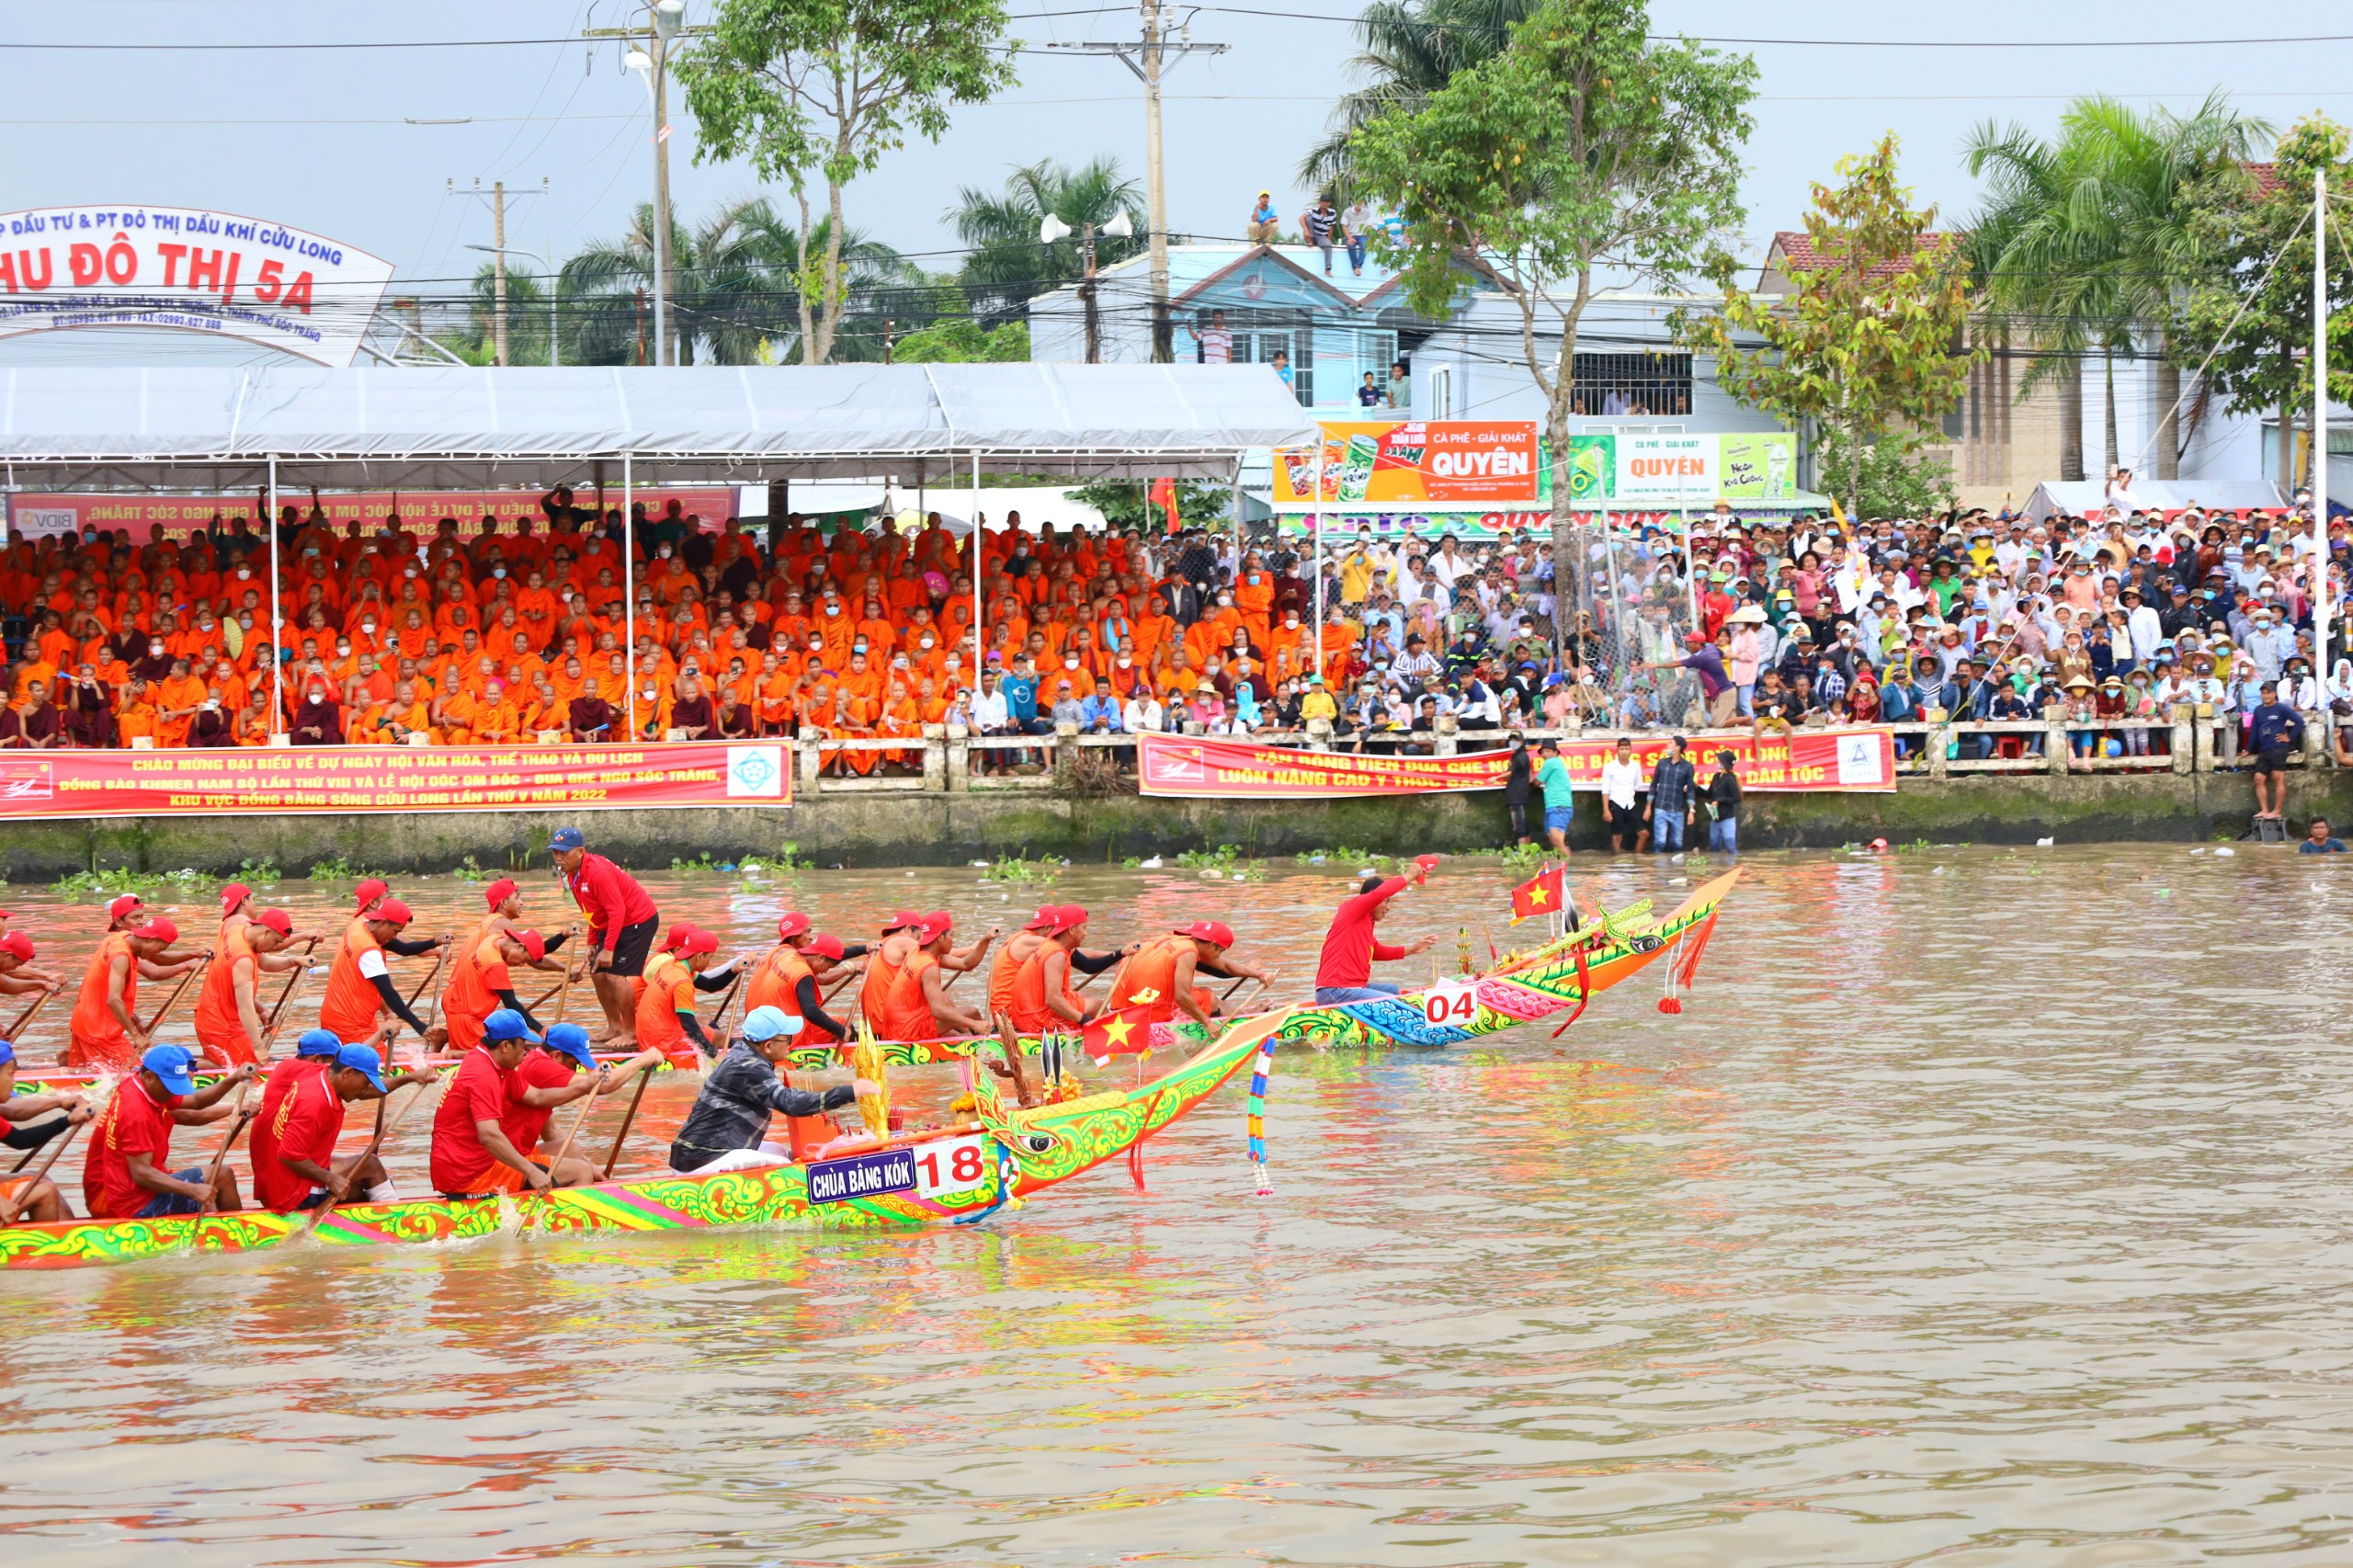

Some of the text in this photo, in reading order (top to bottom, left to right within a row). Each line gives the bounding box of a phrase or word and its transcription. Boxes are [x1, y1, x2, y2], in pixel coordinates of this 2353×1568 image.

[11, 212, 45, 235] ĐẦU
[51, 212, 74, 230] TƯ
[79, 214, 92, 229] &
[96, 212, 117, 227] PT
[122, 210, 145, 228] ĐÔ
[153, 214, 180, 235] THỊ
[186, 213, 220, 234] DẦU
[224, 222, 257, 241] KHÍ
[260, 226, 295, 250] CỬU
[298, 239, 342, 266] LONG
[68, 232, 138, 288] ĐÔ
[157, 243, 241, 306] THỊ
[254, 258, 313, 315] 5A
[1433, 432, 1448, 443] CÀ
[1450, 431, 1469, 443] PHÊ
[1478, 431, 1498, 443] GIẢI
[1501, 431, 1528, 443] KHÁT
[1432, 446, 1528, 476] QUYÊN
[1631, 456, 1705, 478] QUYÊN
[1480, 512, 1591, 534] QUYN
[132, 757, 175, 771] CHÀO
[177, 756, 223, 770] MỪNG
[227, 757, 253, 772] ĐẠI
[257, 755, 291, 770] BIỂU
[318, 756, 340, 770] DỰ
[343, 755, 382, 768] NGÀY
[387, 755, 412, 769] HỘI
[416, 755, 447, 767] VĂN
[450, 754, 486, 767] HÓA,
[521, 754, 559, 766] THAO
[563, 752, 582, 765] VÀ
[586, 754, 606, 764] DU
[610, 753, 643, 766] LỊCH
[1447, 760, 1485, 773] GHE
[105, 778, 136, 790] BÀO
[140, 779, 194, 790] KHMER
[198, 778, 233, 790] NAM
[237, 777, 259, 791] BỘ
[294, 777, 324, 789] THỨ
[326, 777, 351, 789] VIII
[355, 774, 374, 788] VÀ
[379, 773, 395, 788] LỄ
[400, 774, 425, 790] HỘI
[428, 774, 459, 787] OÓC
[462, 775, 486, 787] OM
[490, 773, 520, 786] BÓC
[534, 774, 563, 784] ĐUA
[567, 773, 596, 784] GHE
[600, 772, 631, 783] NGO
[635, 769, 665, 782] SÓC
[669, 769, 721, 782] TRĂNG,
[1218, 767, 1267, 784] LUÔN
[1273, 768, 1327, 786] NÂNG
[1333, 772, 1371, 786] CAO
[1746, 768, 1786, 784] DÂN
[1790, 765, 1825, 785] TỘC
[170, 794, 200, 806] KHU
[205, 793, 234, 808] VỰC
[330, 792, 371, 805] SÔNG
[376, 790, 405, 805] CỬU
[410, 793, 449, 804] LONG
[487, 790, 517, 802] THỨ
[518, 790, 528, 801] V
[531, 790, 567, 801] NĂM
[571, 790, 607, 801] 2022
[1427, 992, 1474, 1023] 04
[917, 1145, 983, 1188] 18
[813, 1157, 911, 1199] CHÙA BÂNG KÓK
